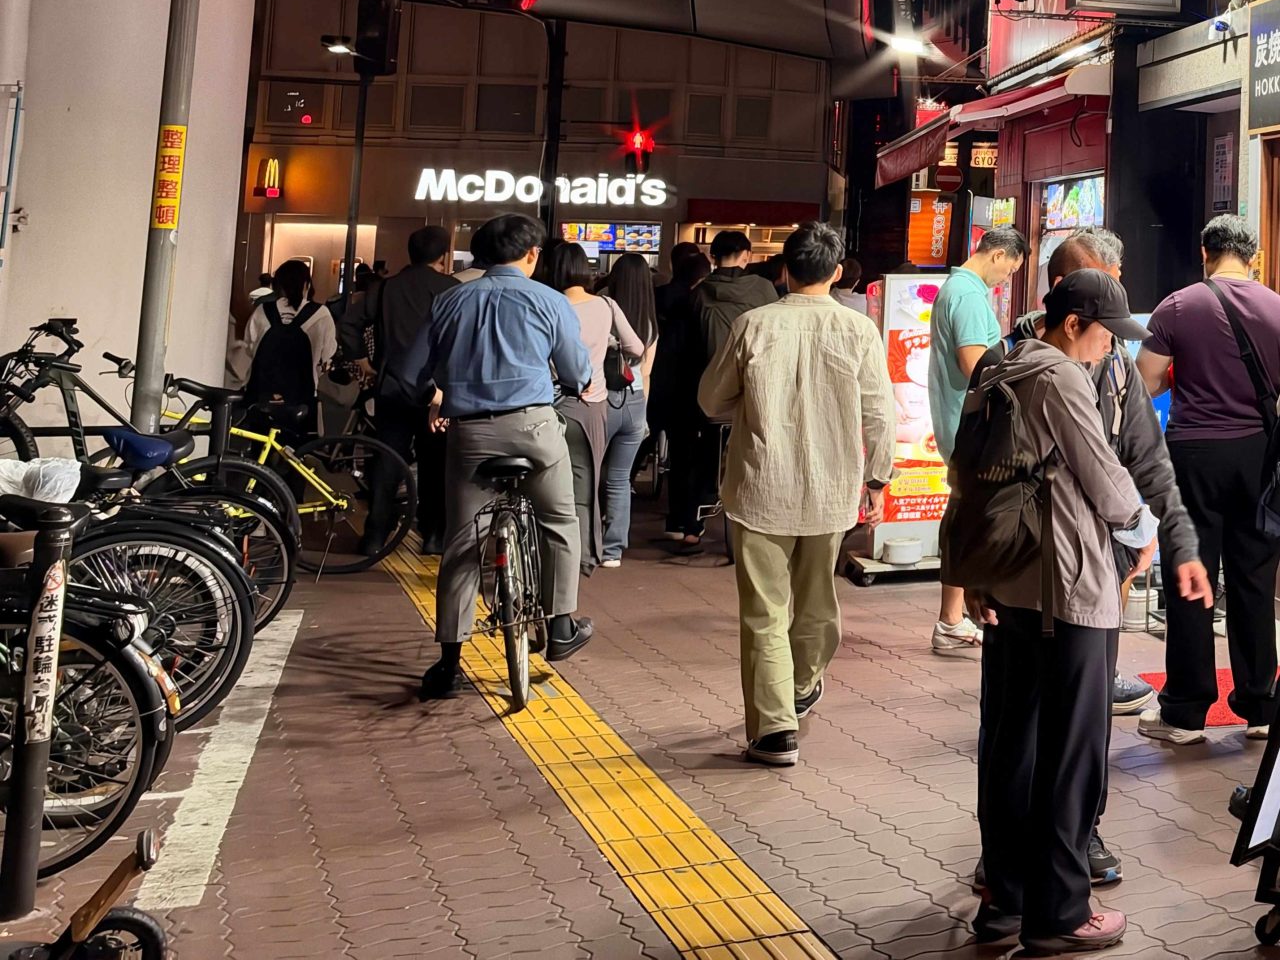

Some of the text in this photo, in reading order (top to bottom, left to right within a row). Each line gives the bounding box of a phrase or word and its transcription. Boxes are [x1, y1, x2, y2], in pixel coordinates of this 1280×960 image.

[155, 129, 184, 225] 整理整頓
[974, 156, 998, 166] GYOZ
[415, 168, 667, 206] McDonald's
